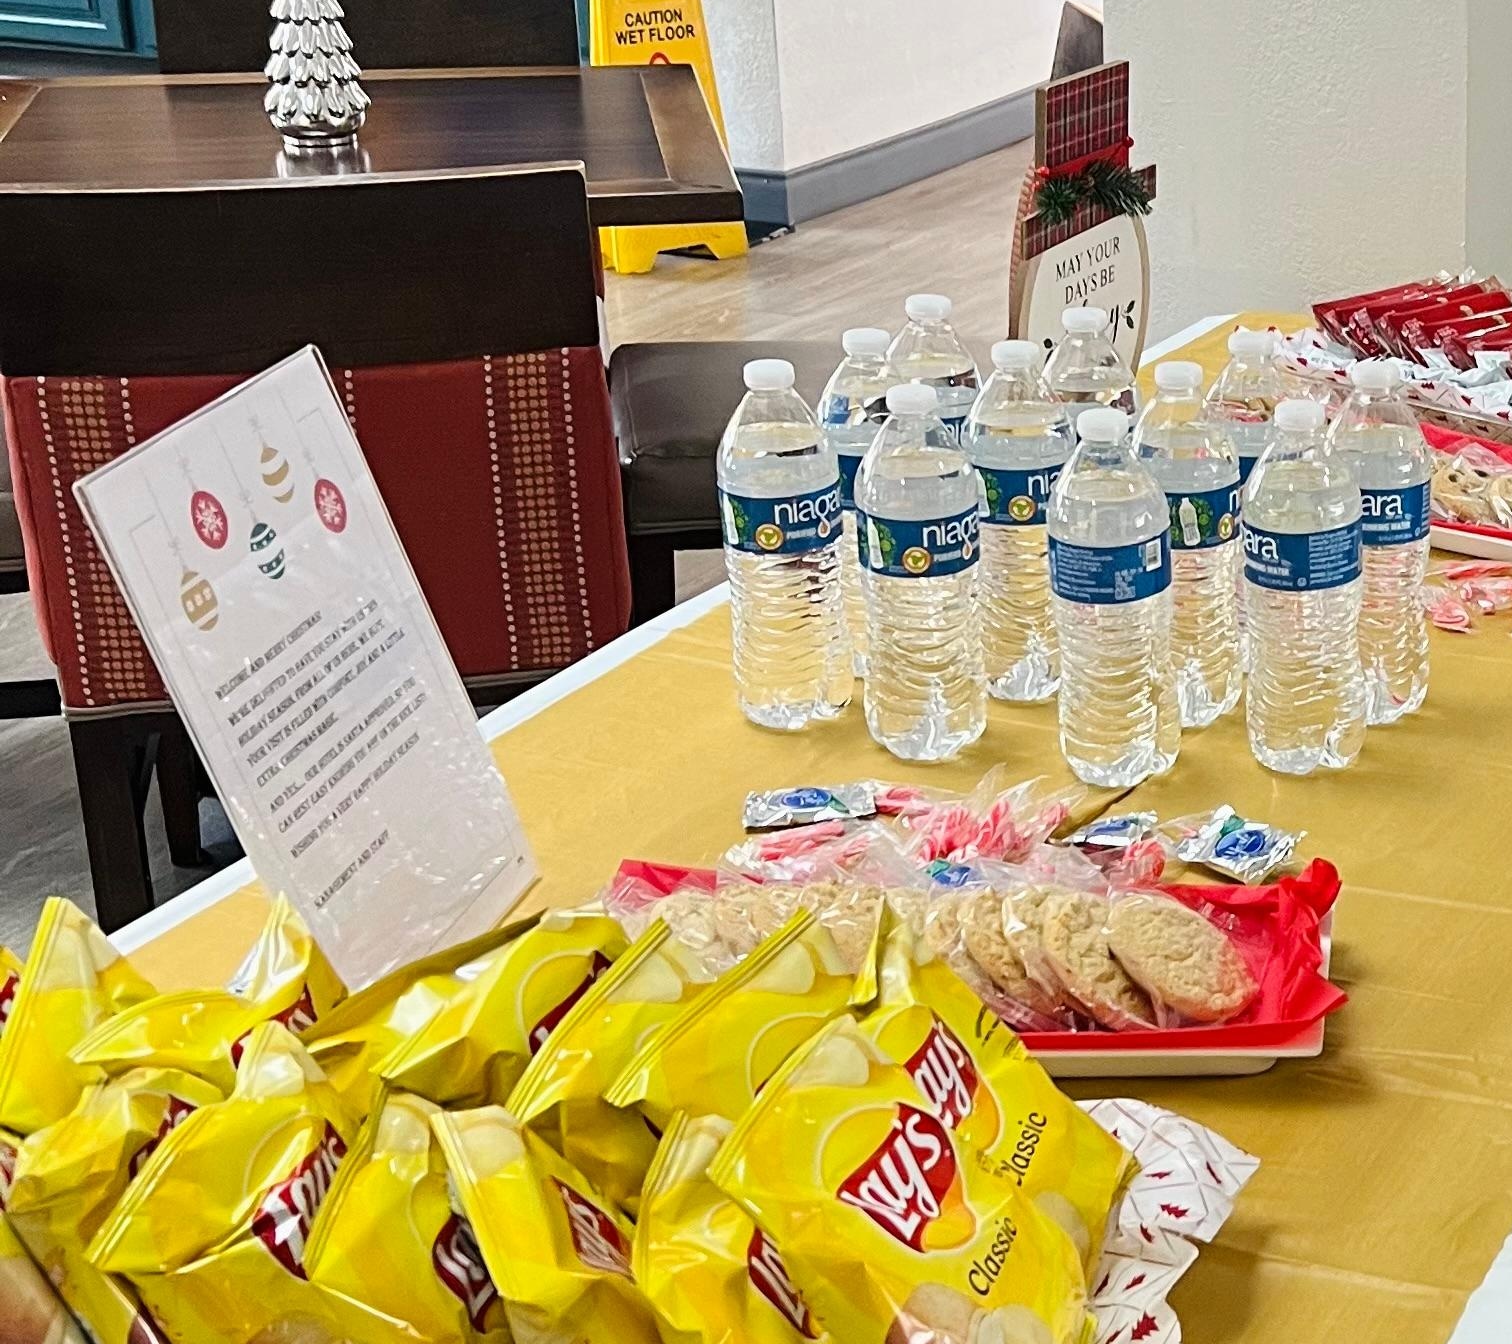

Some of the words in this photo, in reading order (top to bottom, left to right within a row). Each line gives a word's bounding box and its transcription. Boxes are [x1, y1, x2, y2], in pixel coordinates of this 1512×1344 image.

[615, 29, 645, 45] WET
[649, 24, 696, 42] FLOOR
[624, 8, 683, 27] CAUTION
[1056, 252, 1083, 282] MAY
[1087, 236, 1120, 266] YOUR
[1065, 273, 1097, 304] DAYS
[1100, 264, 1116, 288] BE
[774, 490, 840, 538] niaga
[922, 511, 978, 560] niaga
[914, 1021, 972, 1128] ay's
[1003, 1112, 1047, 1187] lassic
[841, 1113, 942, 1241] Lay's
[968, 1216, 1019, 1297] Classic
